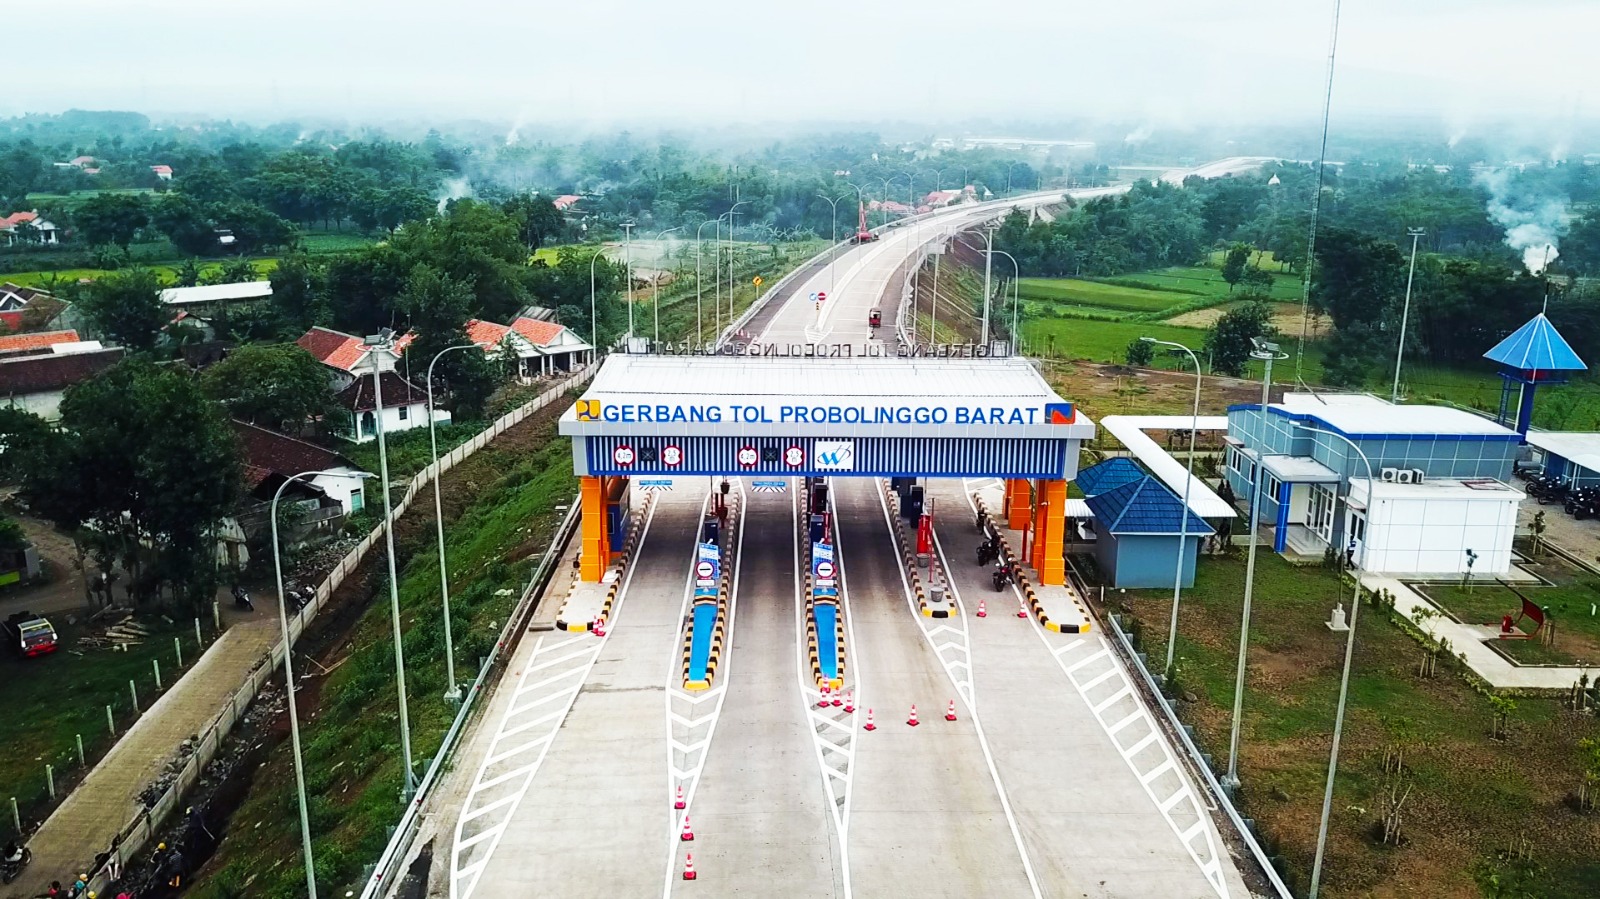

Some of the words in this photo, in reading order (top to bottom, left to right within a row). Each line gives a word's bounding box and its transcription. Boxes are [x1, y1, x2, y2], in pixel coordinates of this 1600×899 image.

[603, 404, 722, 423] GERBANG
[730, 405, 773, 424] TOL
[779, 406, 948, 425] PROBOLINGGO
[955, 407, 1039, 425] BARAT
